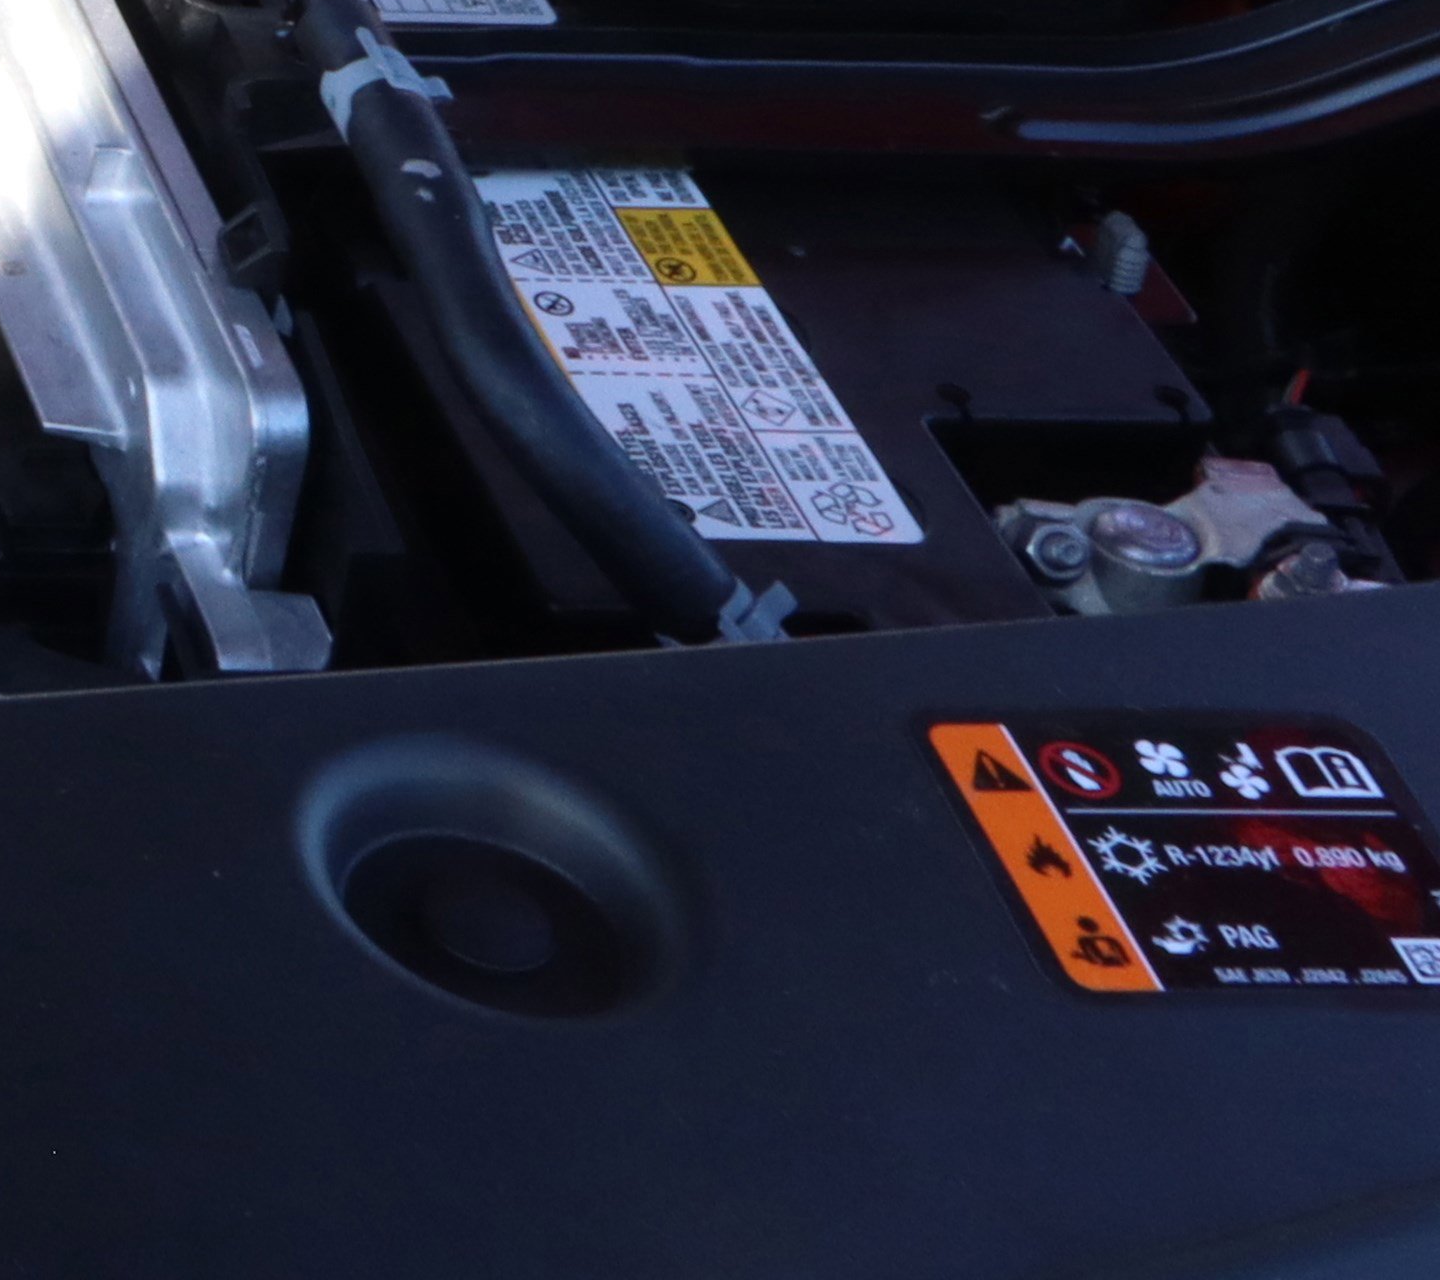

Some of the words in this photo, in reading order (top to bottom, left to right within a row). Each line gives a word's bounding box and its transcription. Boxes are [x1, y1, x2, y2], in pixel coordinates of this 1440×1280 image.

[1152, 778, 1213, 799] AUTO
[1163, 843, 1280, 872] R-1234yf
[1291, 844, 1368, 869] 0.890
[1364, 846, 1408, 873] kg
[1216, 923, 1280, 950] PAG
